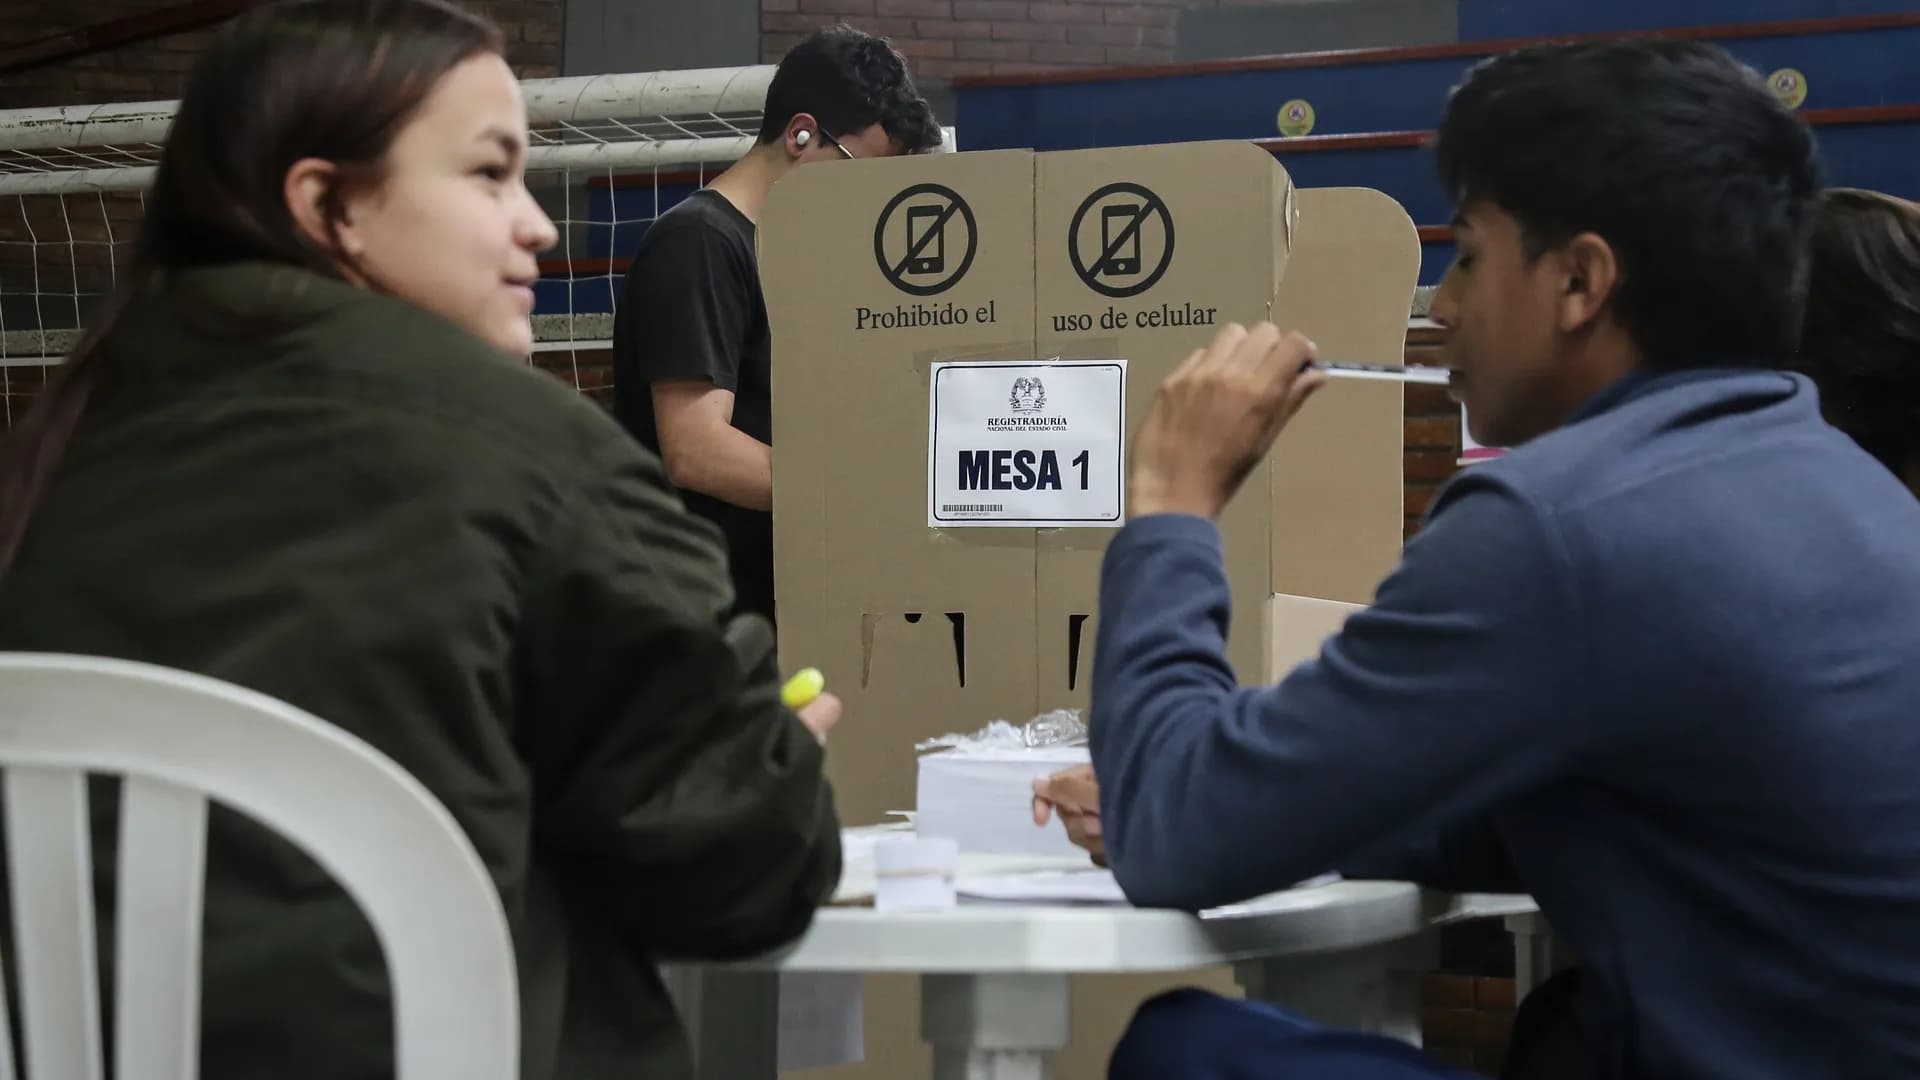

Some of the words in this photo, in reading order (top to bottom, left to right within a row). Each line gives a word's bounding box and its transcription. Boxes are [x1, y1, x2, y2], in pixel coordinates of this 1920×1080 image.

[855, 303, 968, 330] Prohibido
[975, 300, 997, 323] el
[1052, 311, 1093, 332] uso
[1100, 306, 1129, 330] de
[1135, 302, 1218, 327] celular
[987, 415, 1068, 426] REGISTRADURÍA
[958, 449, 1063, 491] MESA
[1072, 449, 1089, 491] 1
